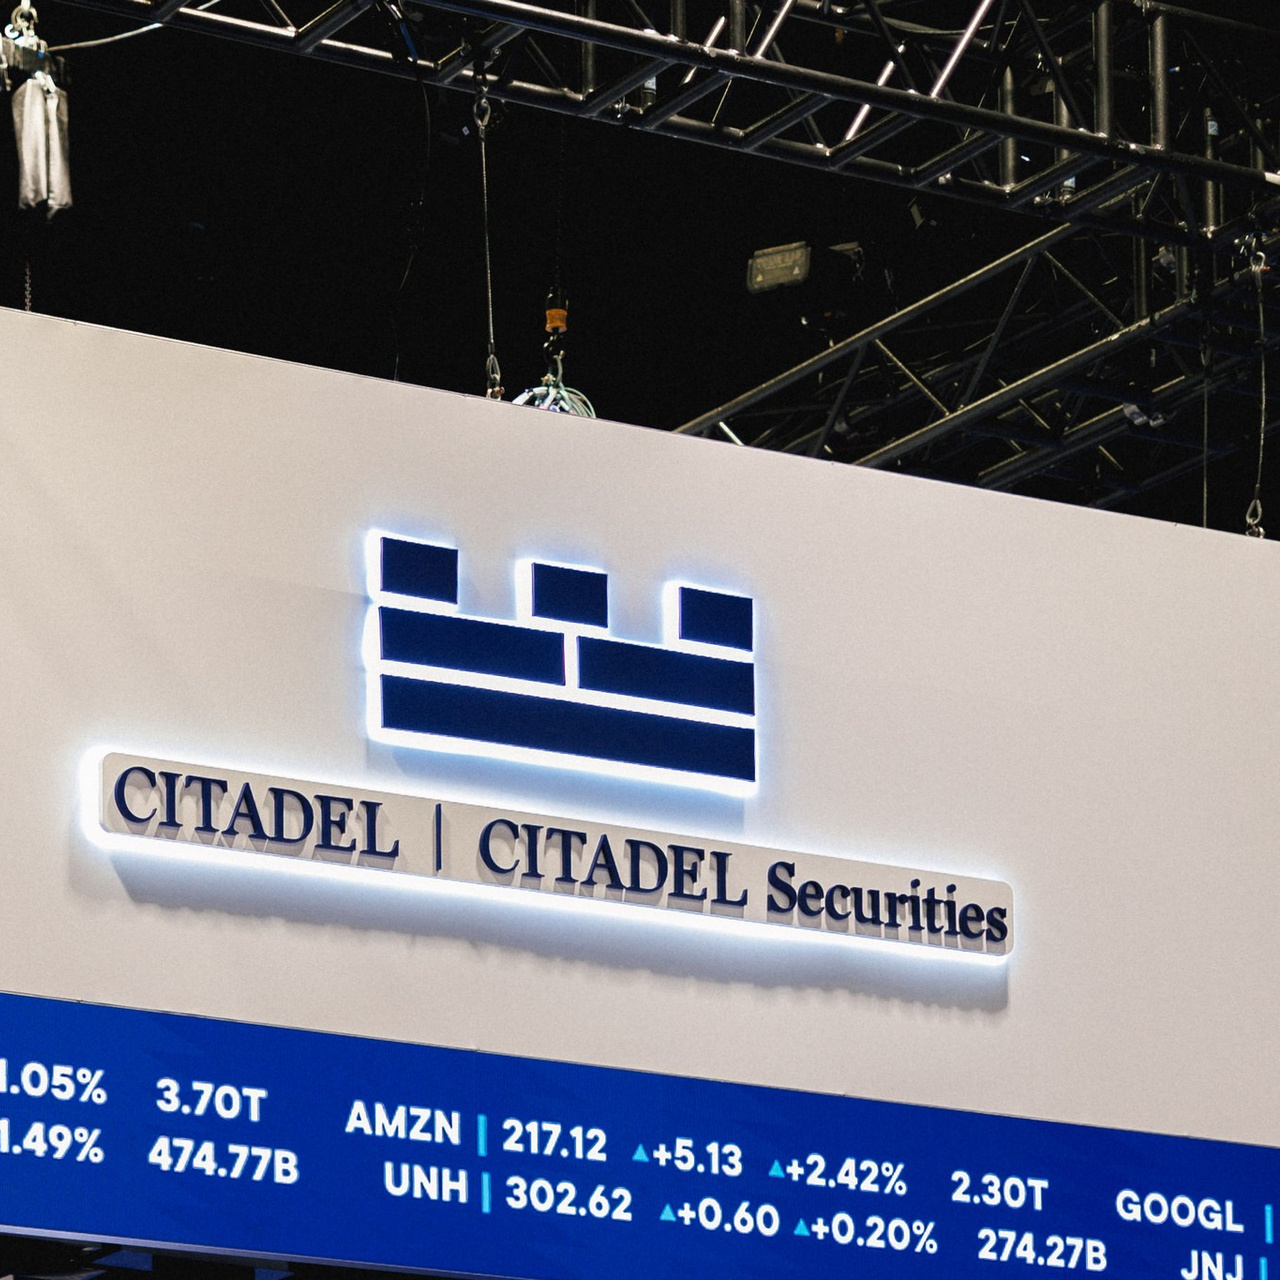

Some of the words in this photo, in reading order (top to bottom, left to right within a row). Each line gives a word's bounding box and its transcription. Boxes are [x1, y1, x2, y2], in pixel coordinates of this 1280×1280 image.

[113, 764, 401, 861] CITADEL
[479, 818, 750, 909] CITADEL
[765, 860, 1010, 945] Securities
[149, 1136, 298, 1184] 474.77B
[385, 1162, 466, 1202] UNH
[506, 1176, 632, 1221] 302.62
[678, 1198, 779, 1236] +0.60
[812, 1213, 937, 1253] +0.20%
[978, 1229, 1106, 1271] 274.27B
[157, 1079, 267, 1121] 3.70T
[346, 1101, 459, 1144] AMZN
[503, 1119, 606, 1161] 217.12
[653, 1138, 742, 1176] +5.13
[787, 1155, 906, 1195] +2.42%
[952, 1171, 1048, 1210] 2.30T
[1117, 1190, 1243, 1232] GOOGL
